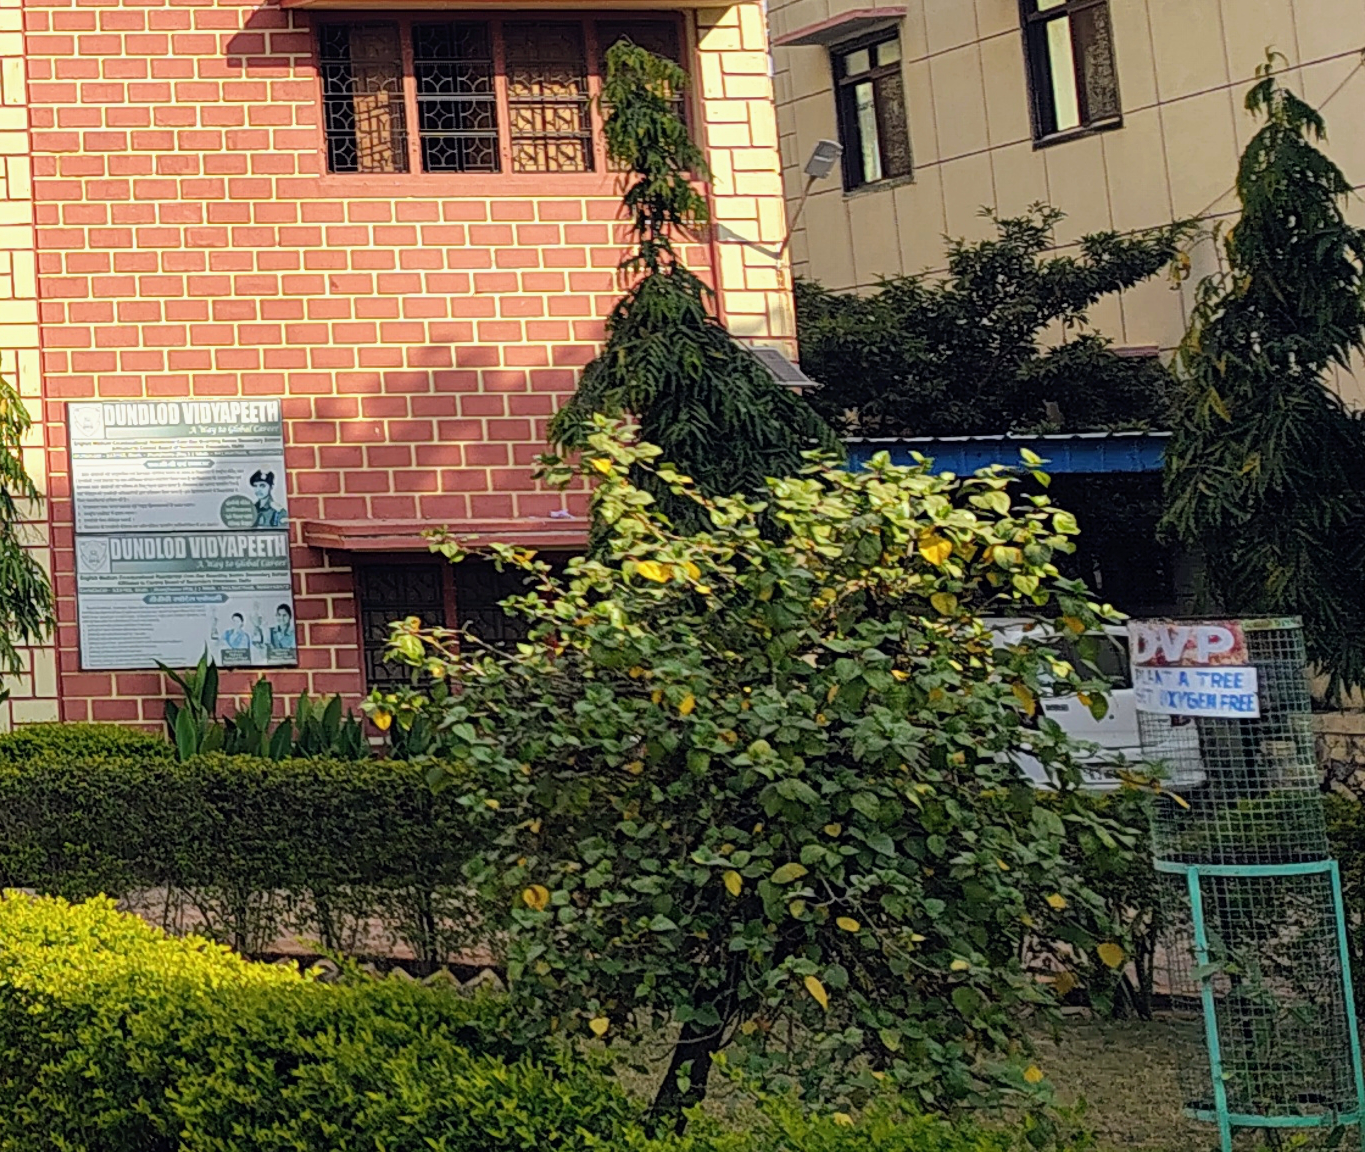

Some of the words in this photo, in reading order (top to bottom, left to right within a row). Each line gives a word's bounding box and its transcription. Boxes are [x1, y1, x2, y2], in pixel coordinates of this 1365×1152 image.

[103, 403, 180, 427] DUNDLOD
[182, 401, 279, 425] VIDYAPEETH
[110, 538, 186, 560] DUNDLOD
[188, 535, 287, 559] VIDYAPEETH
[1135, 625, 1235, 664] DVP
[1178, 671, 1189, 687] A
[1196, 671, 1244, 689] TREE
[1220, 692, 1256, 713] FREE
